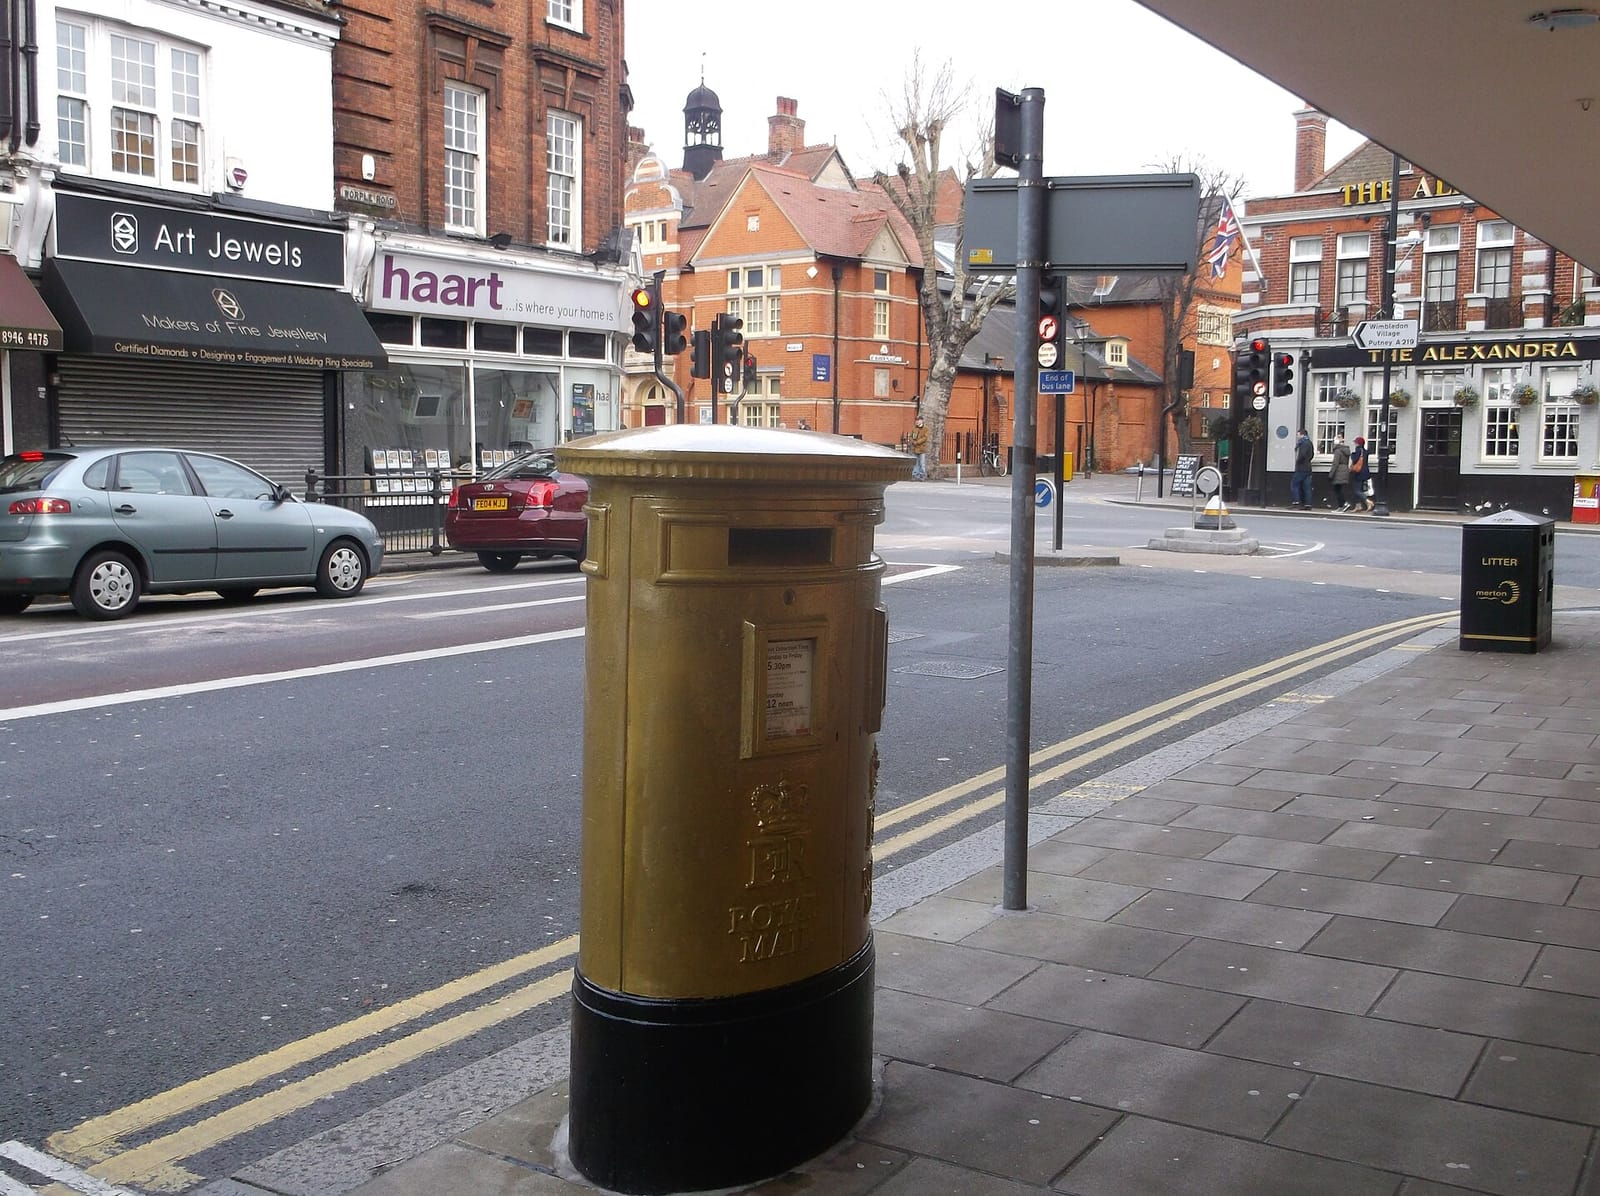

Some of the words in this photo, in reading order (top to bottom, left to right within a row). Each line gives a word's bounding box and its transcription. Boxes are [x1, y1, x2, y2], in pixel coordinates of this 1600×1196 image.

[1341, 179, 1393, 206] THE
[1411, 176, 1460, 199] AL
[154, 224, 195, 255] Art
[208, 231, 302, 268] Jewels
[382, 255, 503, 310] haart
[525, 301, 554, 315] where
[557, 306, 577, 318] your
[580, 307, 605, 320] home
[606, 310, 614, 321] is
[142, 313, 200, 332] Makers
[205, 320, 220, 333] of
[225, 321, 261, 337] Fine
[267, 324, 328, 344] Jewellery
[1369, 322, 1409, 330] Wimbledon
[114, 342, 149, 355] Certified
[150, 345, 189, 358] Diamonds
[200, 348, 236, 362] Designing
[245, 352, 287, 364] Engagement
[288, 354, 293, 364] &
[294, 355, 323, 368] Wedding
[324, 357, 340, 368] Ring
[341, 358, 374, 369] Specialists
[1367, 348, 1413, 362] THE
[1422, 341, 1577, 362] ALEXANDRA
[1045, 374, 1059, 382] End
[1055, 382, 1071, 390] lane
[475, 499, 492, 508] FE04
[1481, 557, 1518, 567] LITTER
[768, 661, 791, 670] 5.30pm
